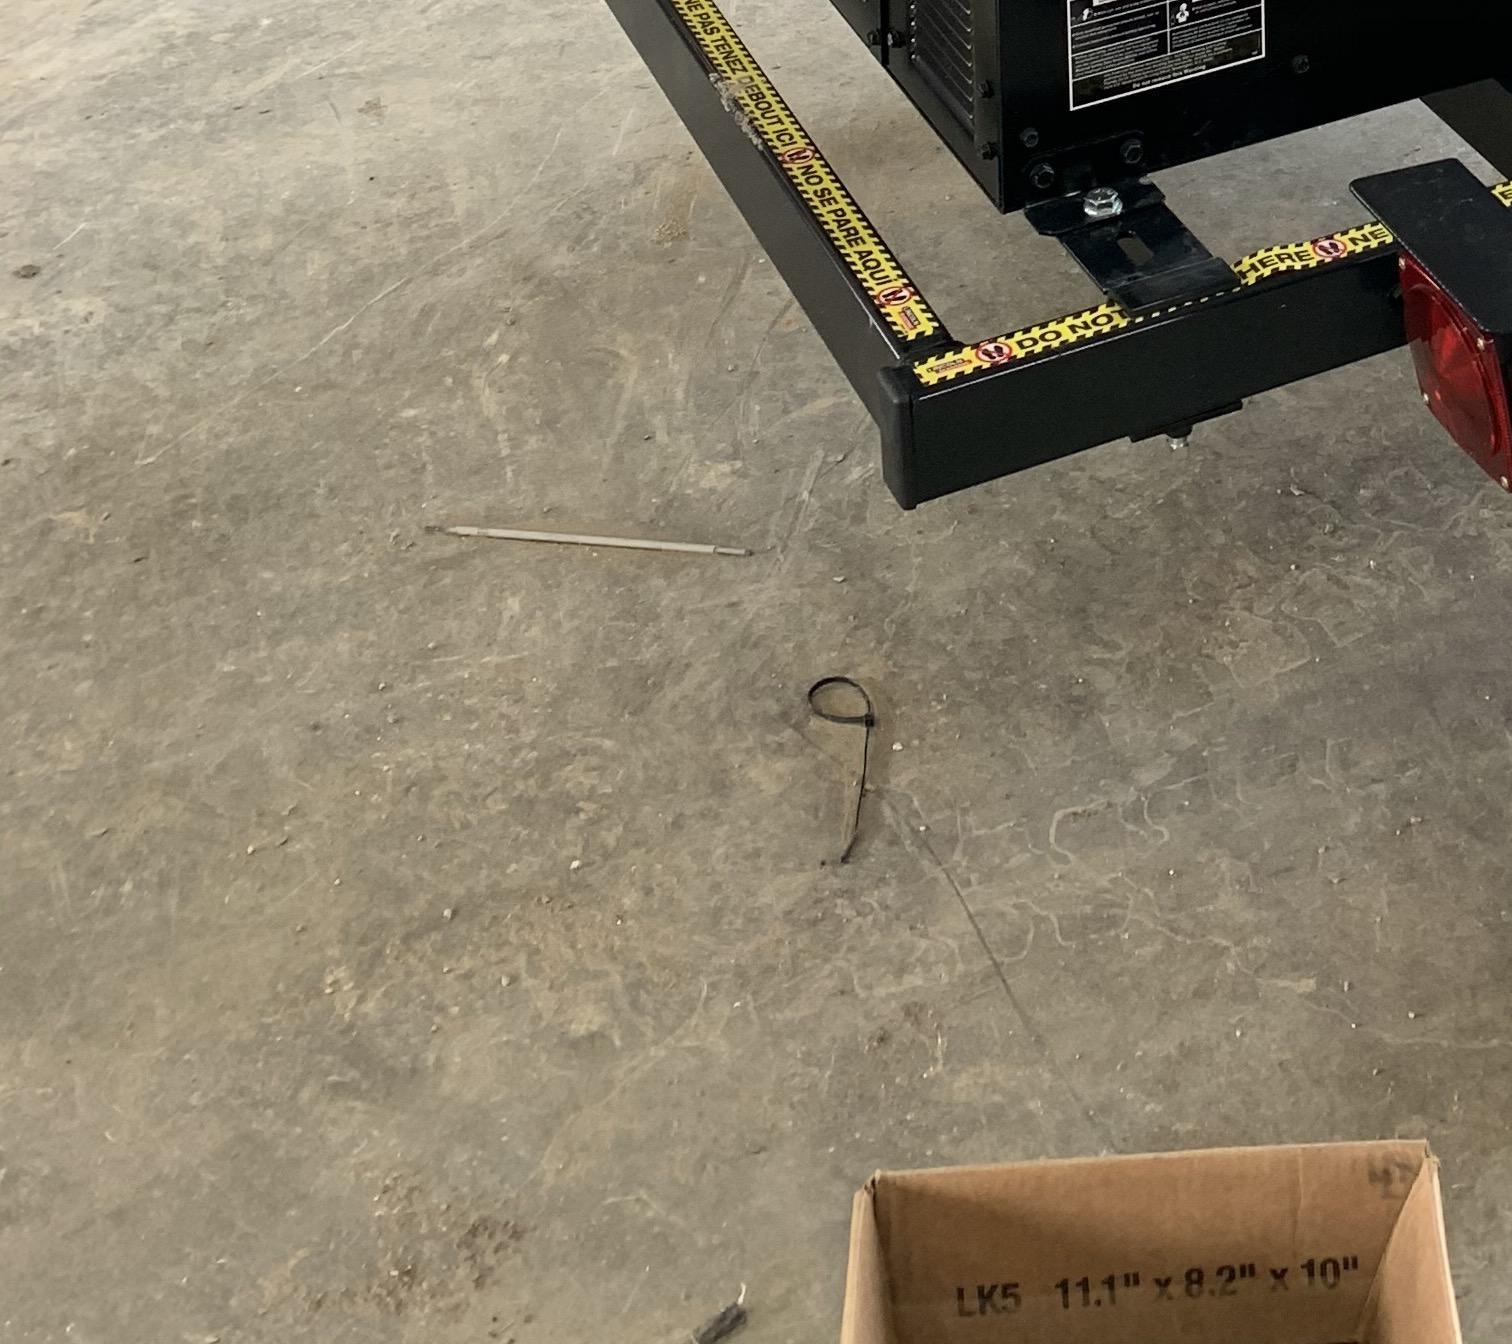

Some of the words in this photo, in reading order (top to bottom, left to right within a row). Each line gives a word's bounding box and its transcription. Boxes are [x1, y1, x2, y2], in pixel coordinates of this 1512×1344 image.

[697, 12, 721, 36] PAS
[711, 35, 748, 75] TENEZ
[738, 75, 785, 129] DEBOUT
[772, 128, 797, 147] ICI
[797, 164, 824, 186] NO
[813, 187, 839, 208] SE
[827, 208, 866, 248] PARE
[1238, 249, 1315, 281] HERE
[1349, 226, 1388, 247] NE
[1016, 329, 1062, 350] DO
[957, 1281, 1021, 1318] LK5
[1055, 1271, 1141, 1310] 11.1"
[1155, 1276, 1174, 1301] x
[1185, 1262, 1256, 1298] 8.2"
[1270, 1266, 1289, 1292] x
[1300, 1255, 1360, 1292] 10"
